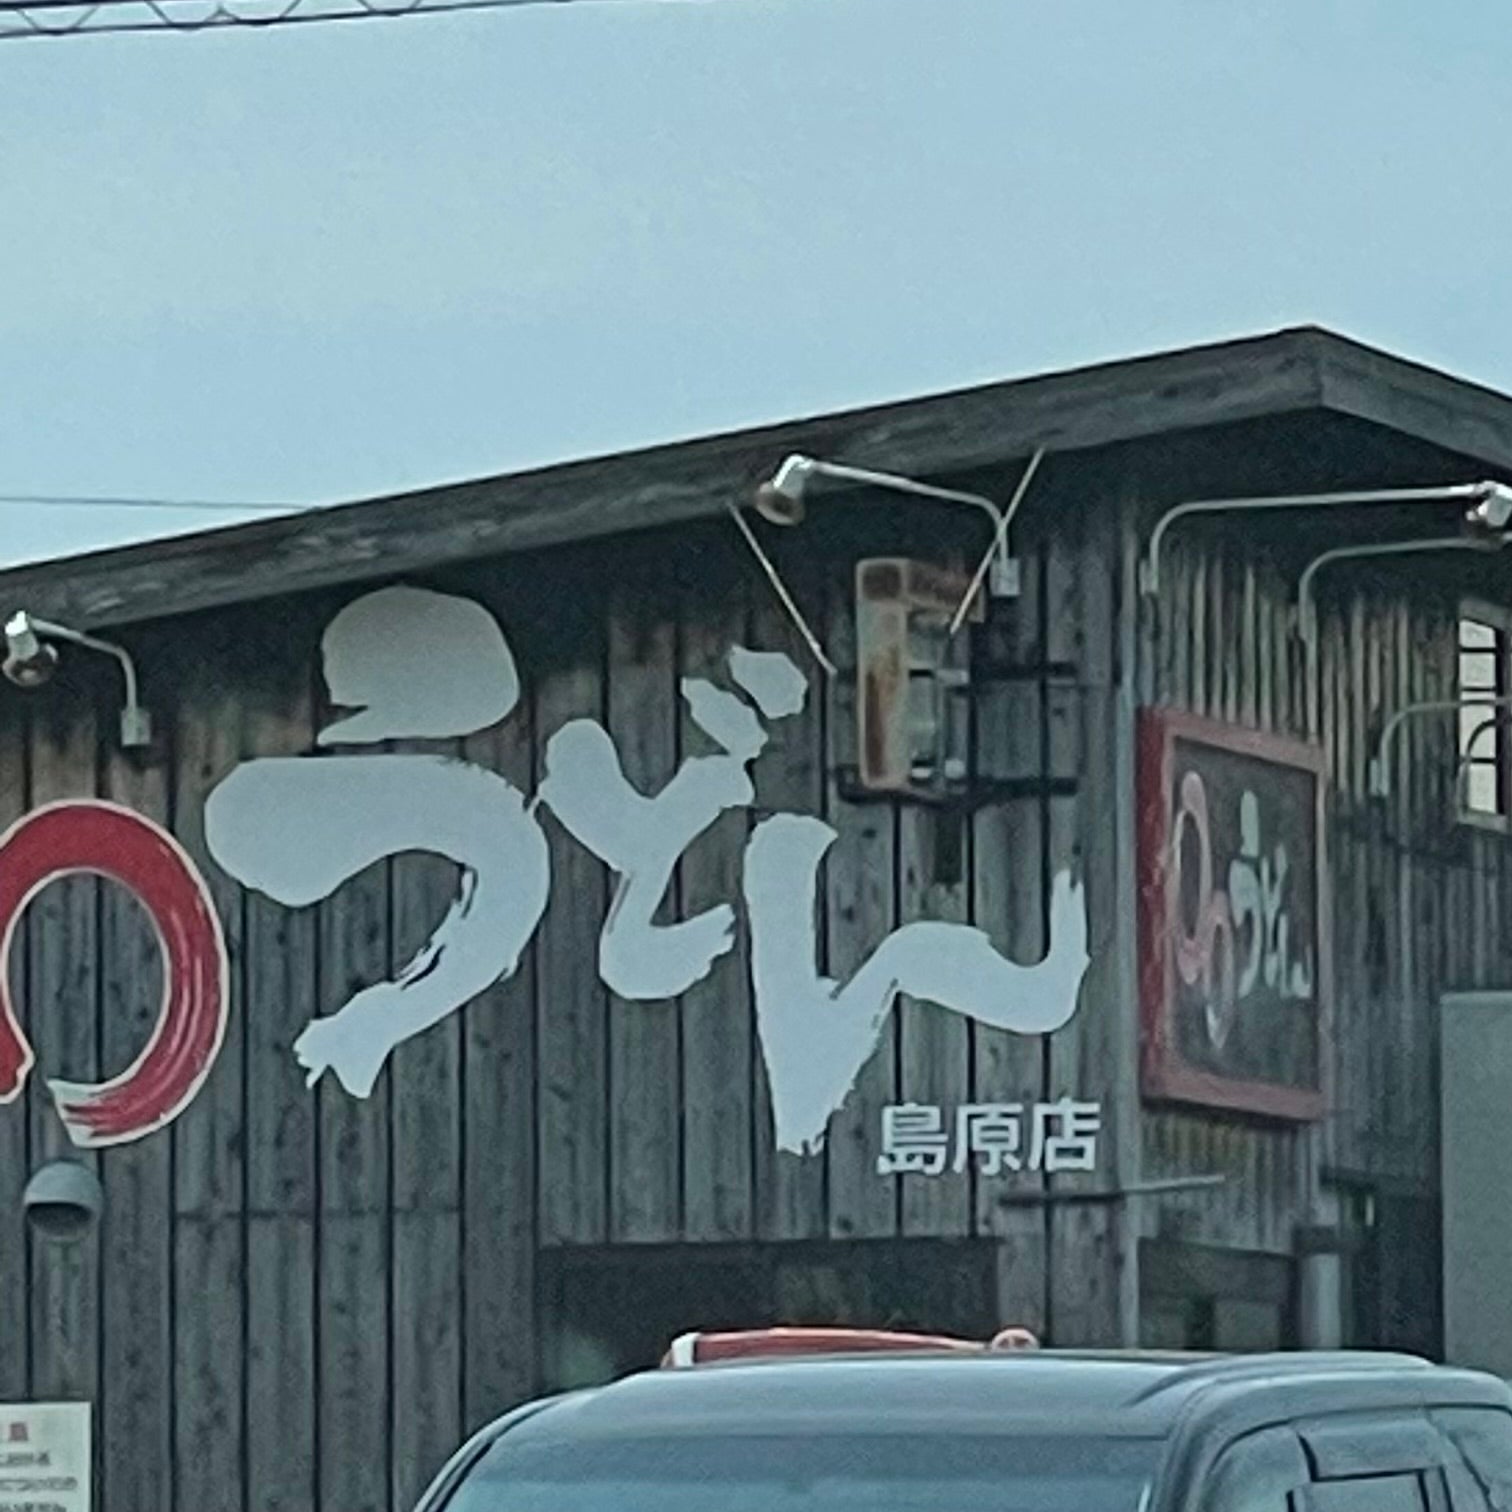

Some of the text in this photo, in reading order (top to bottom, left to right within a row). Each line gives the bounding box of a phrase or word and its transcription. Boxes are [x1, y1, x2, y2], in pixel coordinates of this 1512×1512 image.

[204, 584, 1090, 1156] うどん
[876, 1099, 1101, 1176] 島原店
